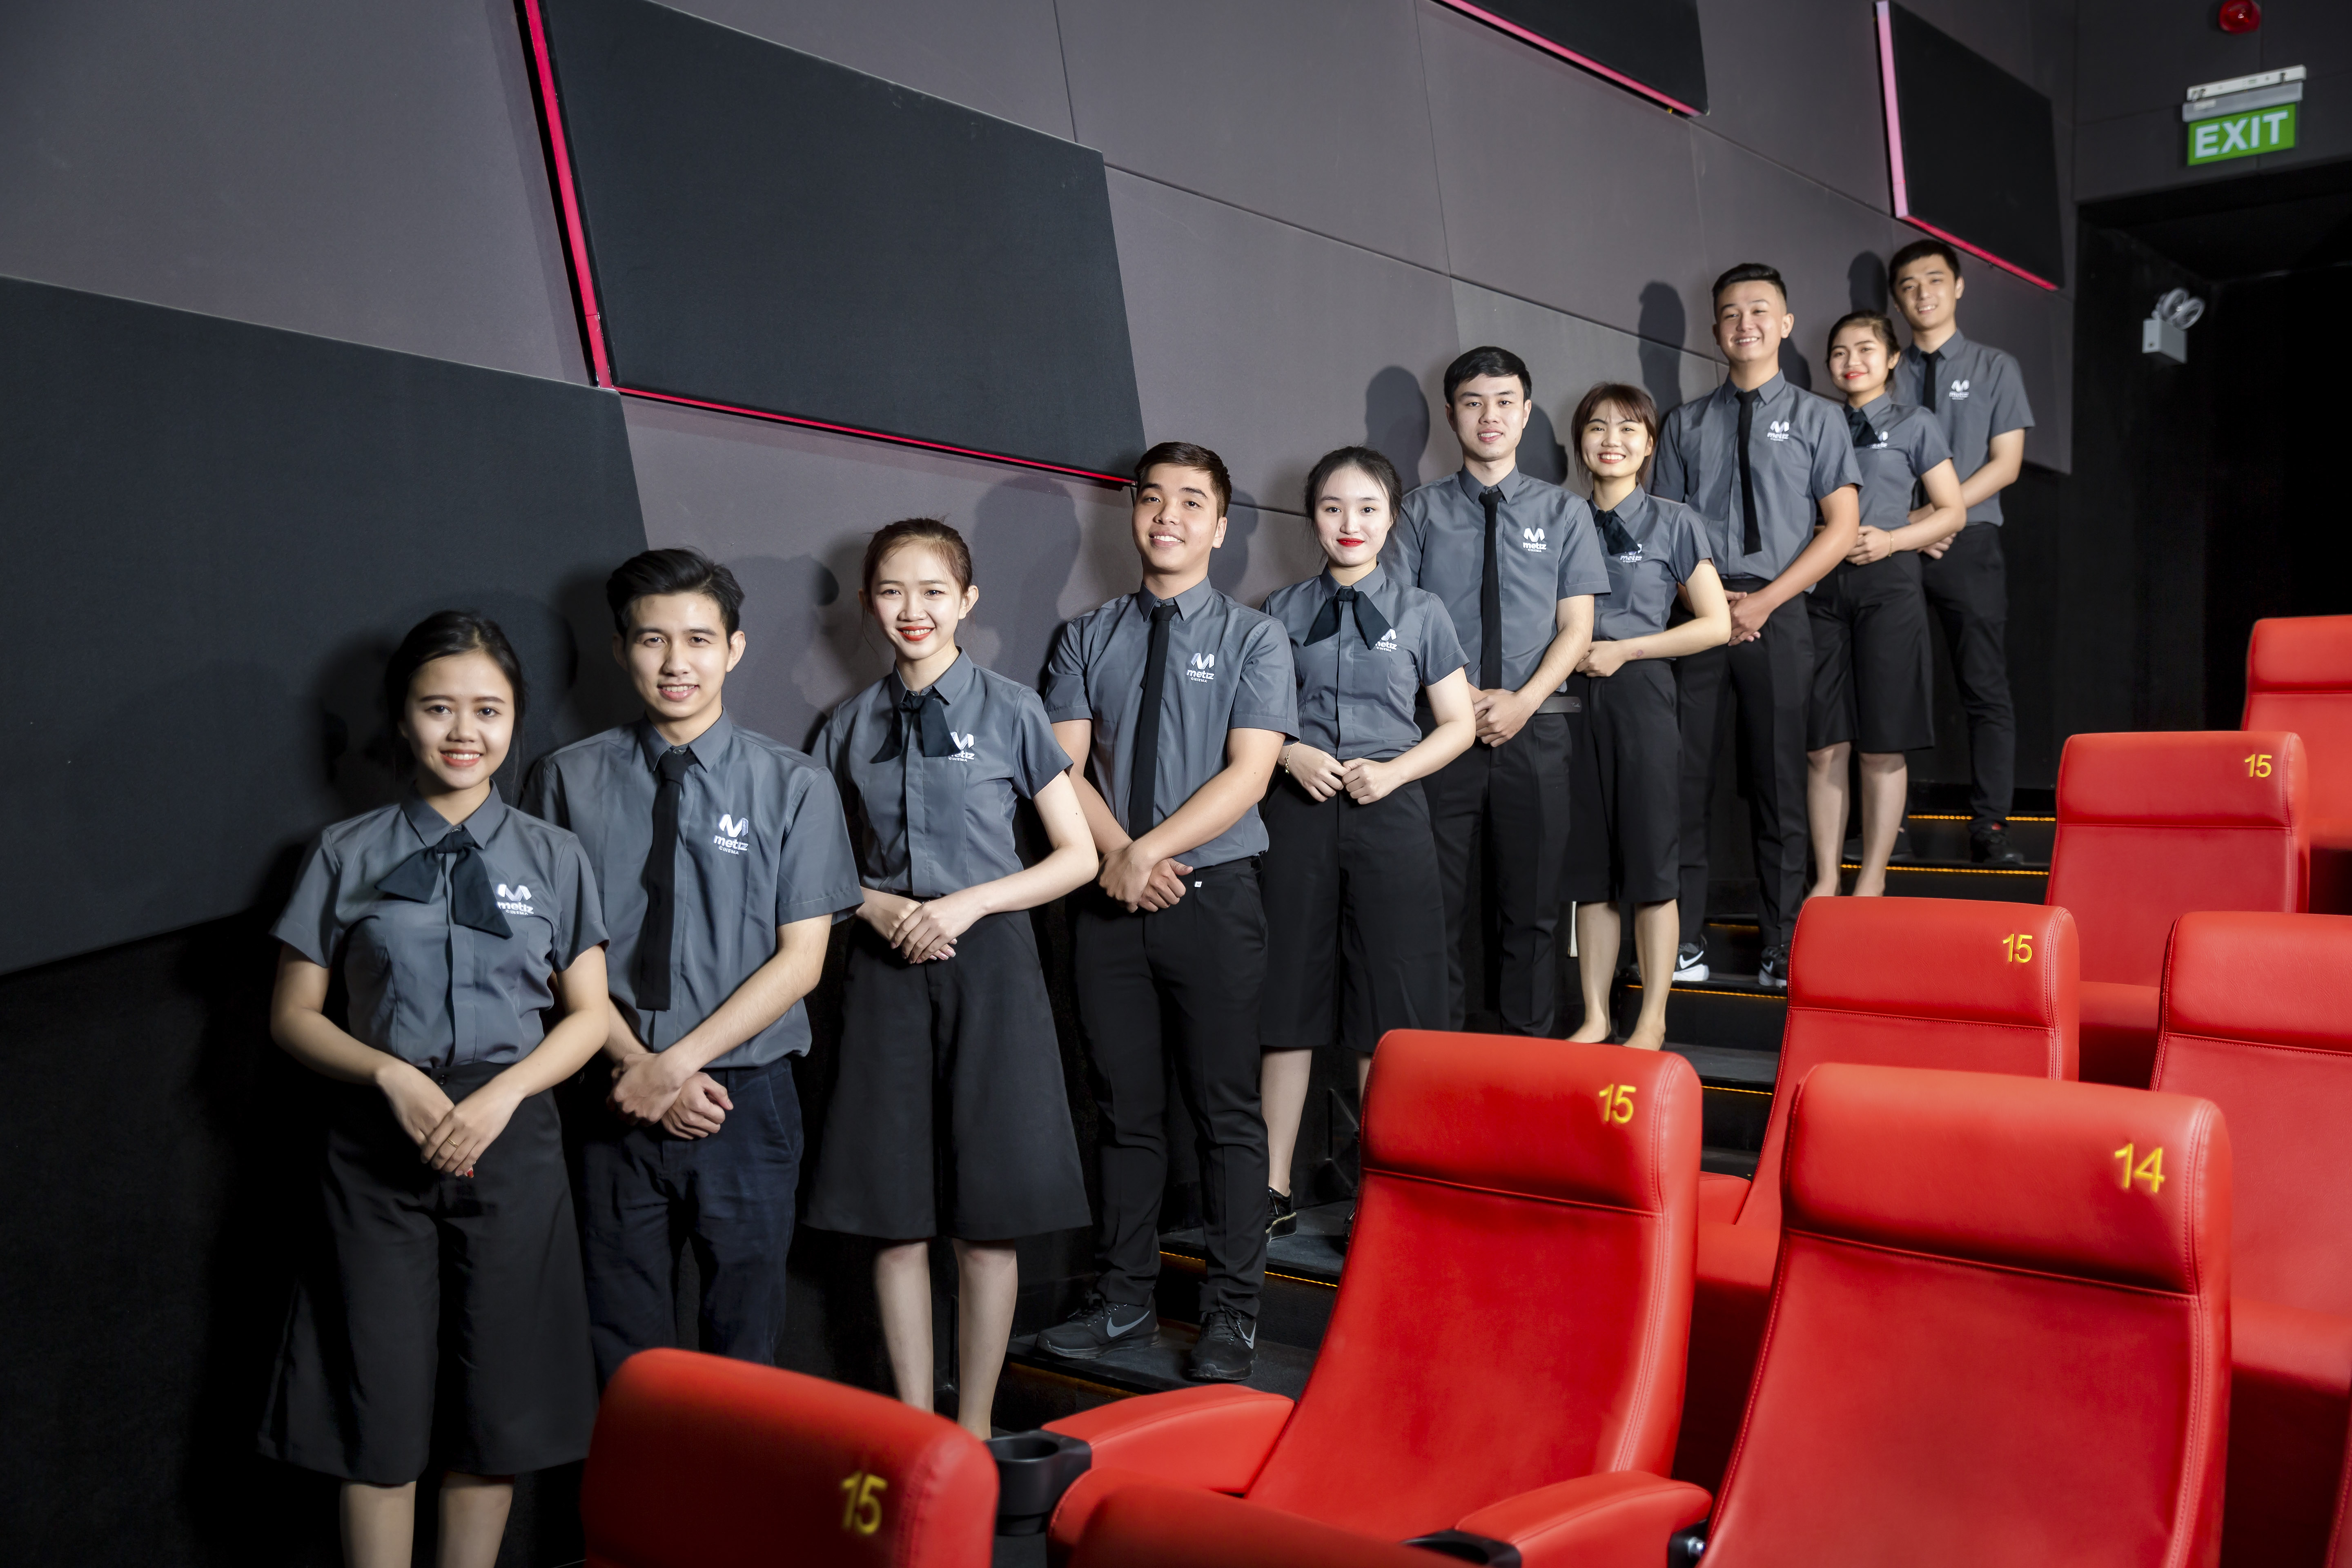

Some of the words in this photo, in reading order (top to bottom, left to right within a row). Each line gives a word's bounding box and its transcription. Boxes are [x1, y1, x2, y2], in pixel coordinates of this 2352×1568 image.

[2194, 110, 2289, 159] EXIT
[1522, 542, 1547, 550] metiz
[1186, 669, 1215, 680] metiz
[2244, 754, 2272, 777] 15
[713, 835, 749, 851] metiz
[719, 846, 739, 855] CINEMA
[497, 901, 534, 914] metiz
[2002, 933, 2033, 963] 15
[1599, 1083, 1637, 1123] 15
[2114, 1143, 2165, 1193] 14
[841, 1471, 888, 1535] 15
